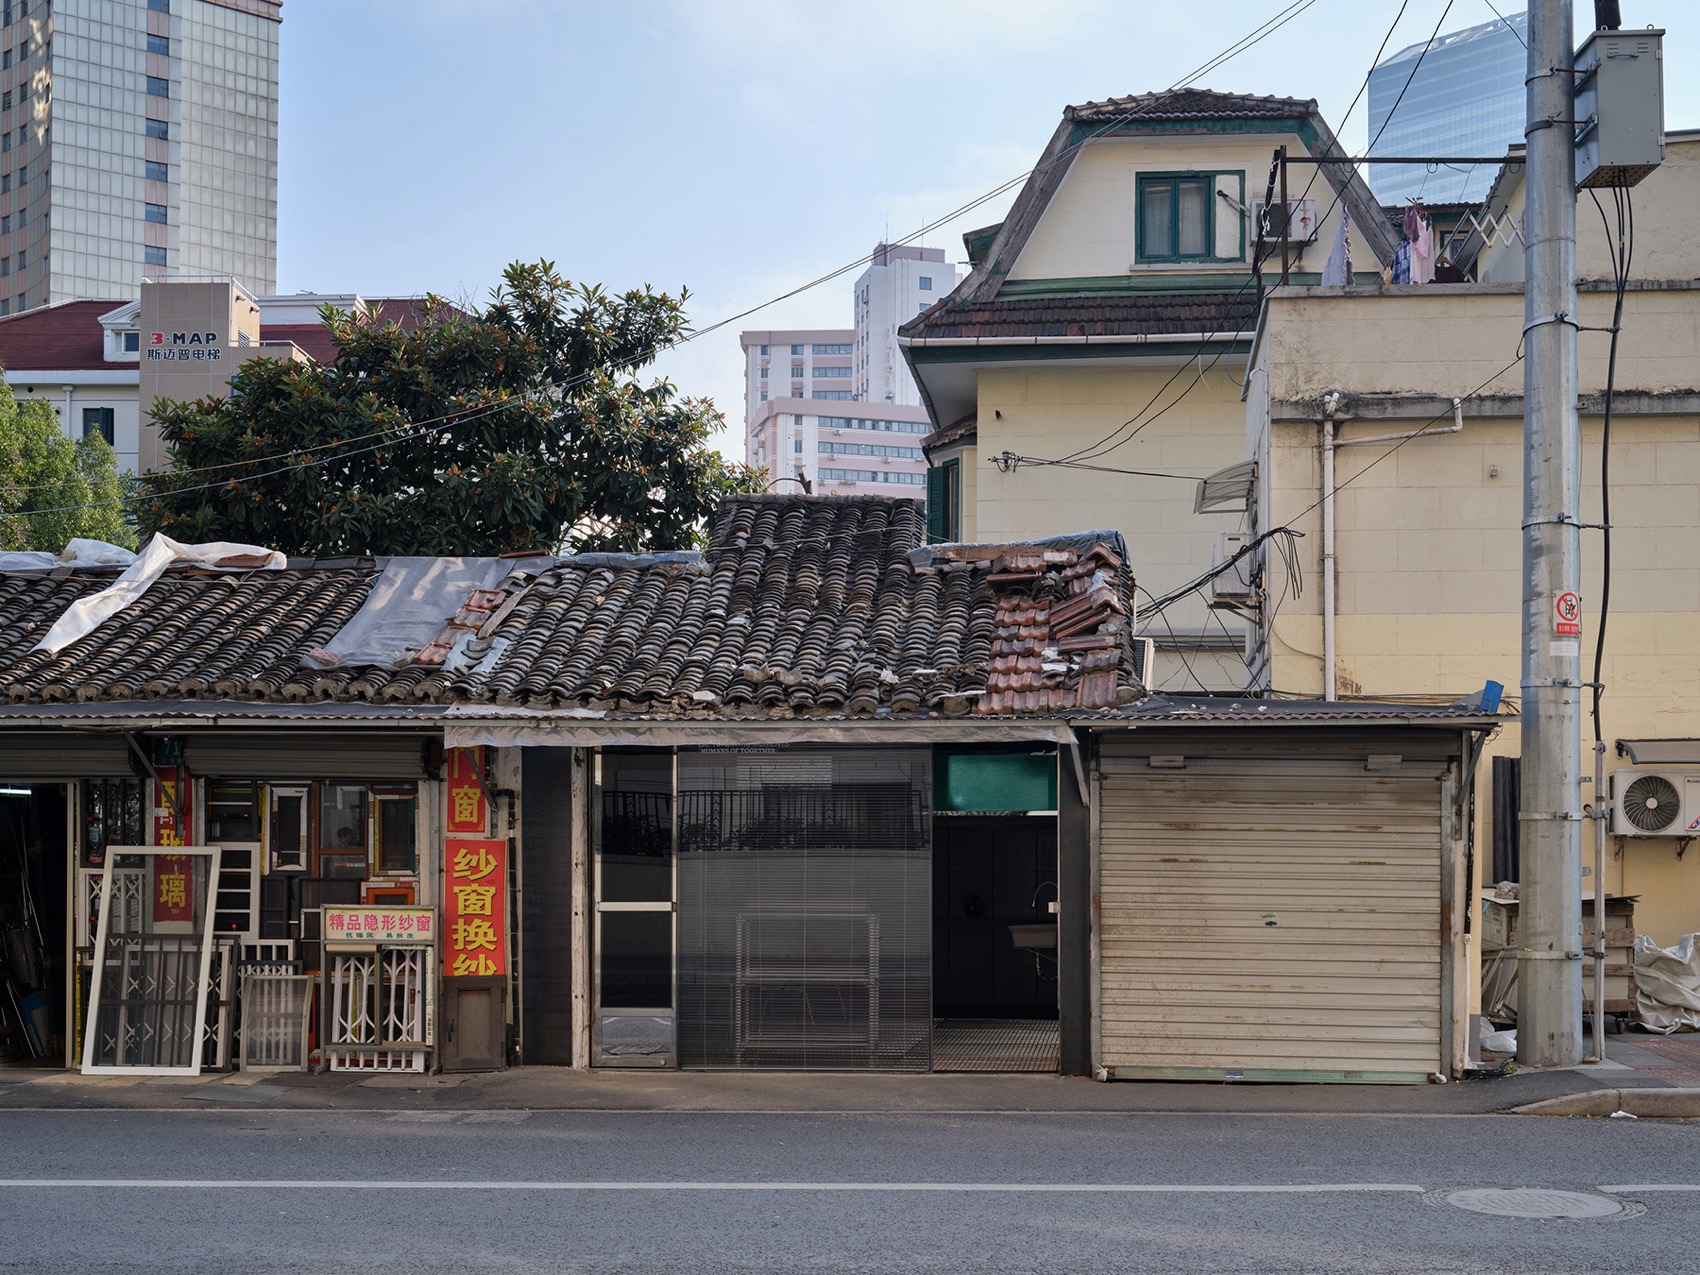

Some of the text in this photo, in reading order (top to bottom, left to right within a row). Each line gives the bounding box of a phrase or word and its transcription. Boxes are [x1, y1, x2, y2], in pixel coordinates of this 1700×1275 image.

[147, 348, 220, 360] 斯迈普电梯
[452, 848, 498, 976] 纱窗换纱
[329, 913, 431, 932] 精品隐形纱窗
